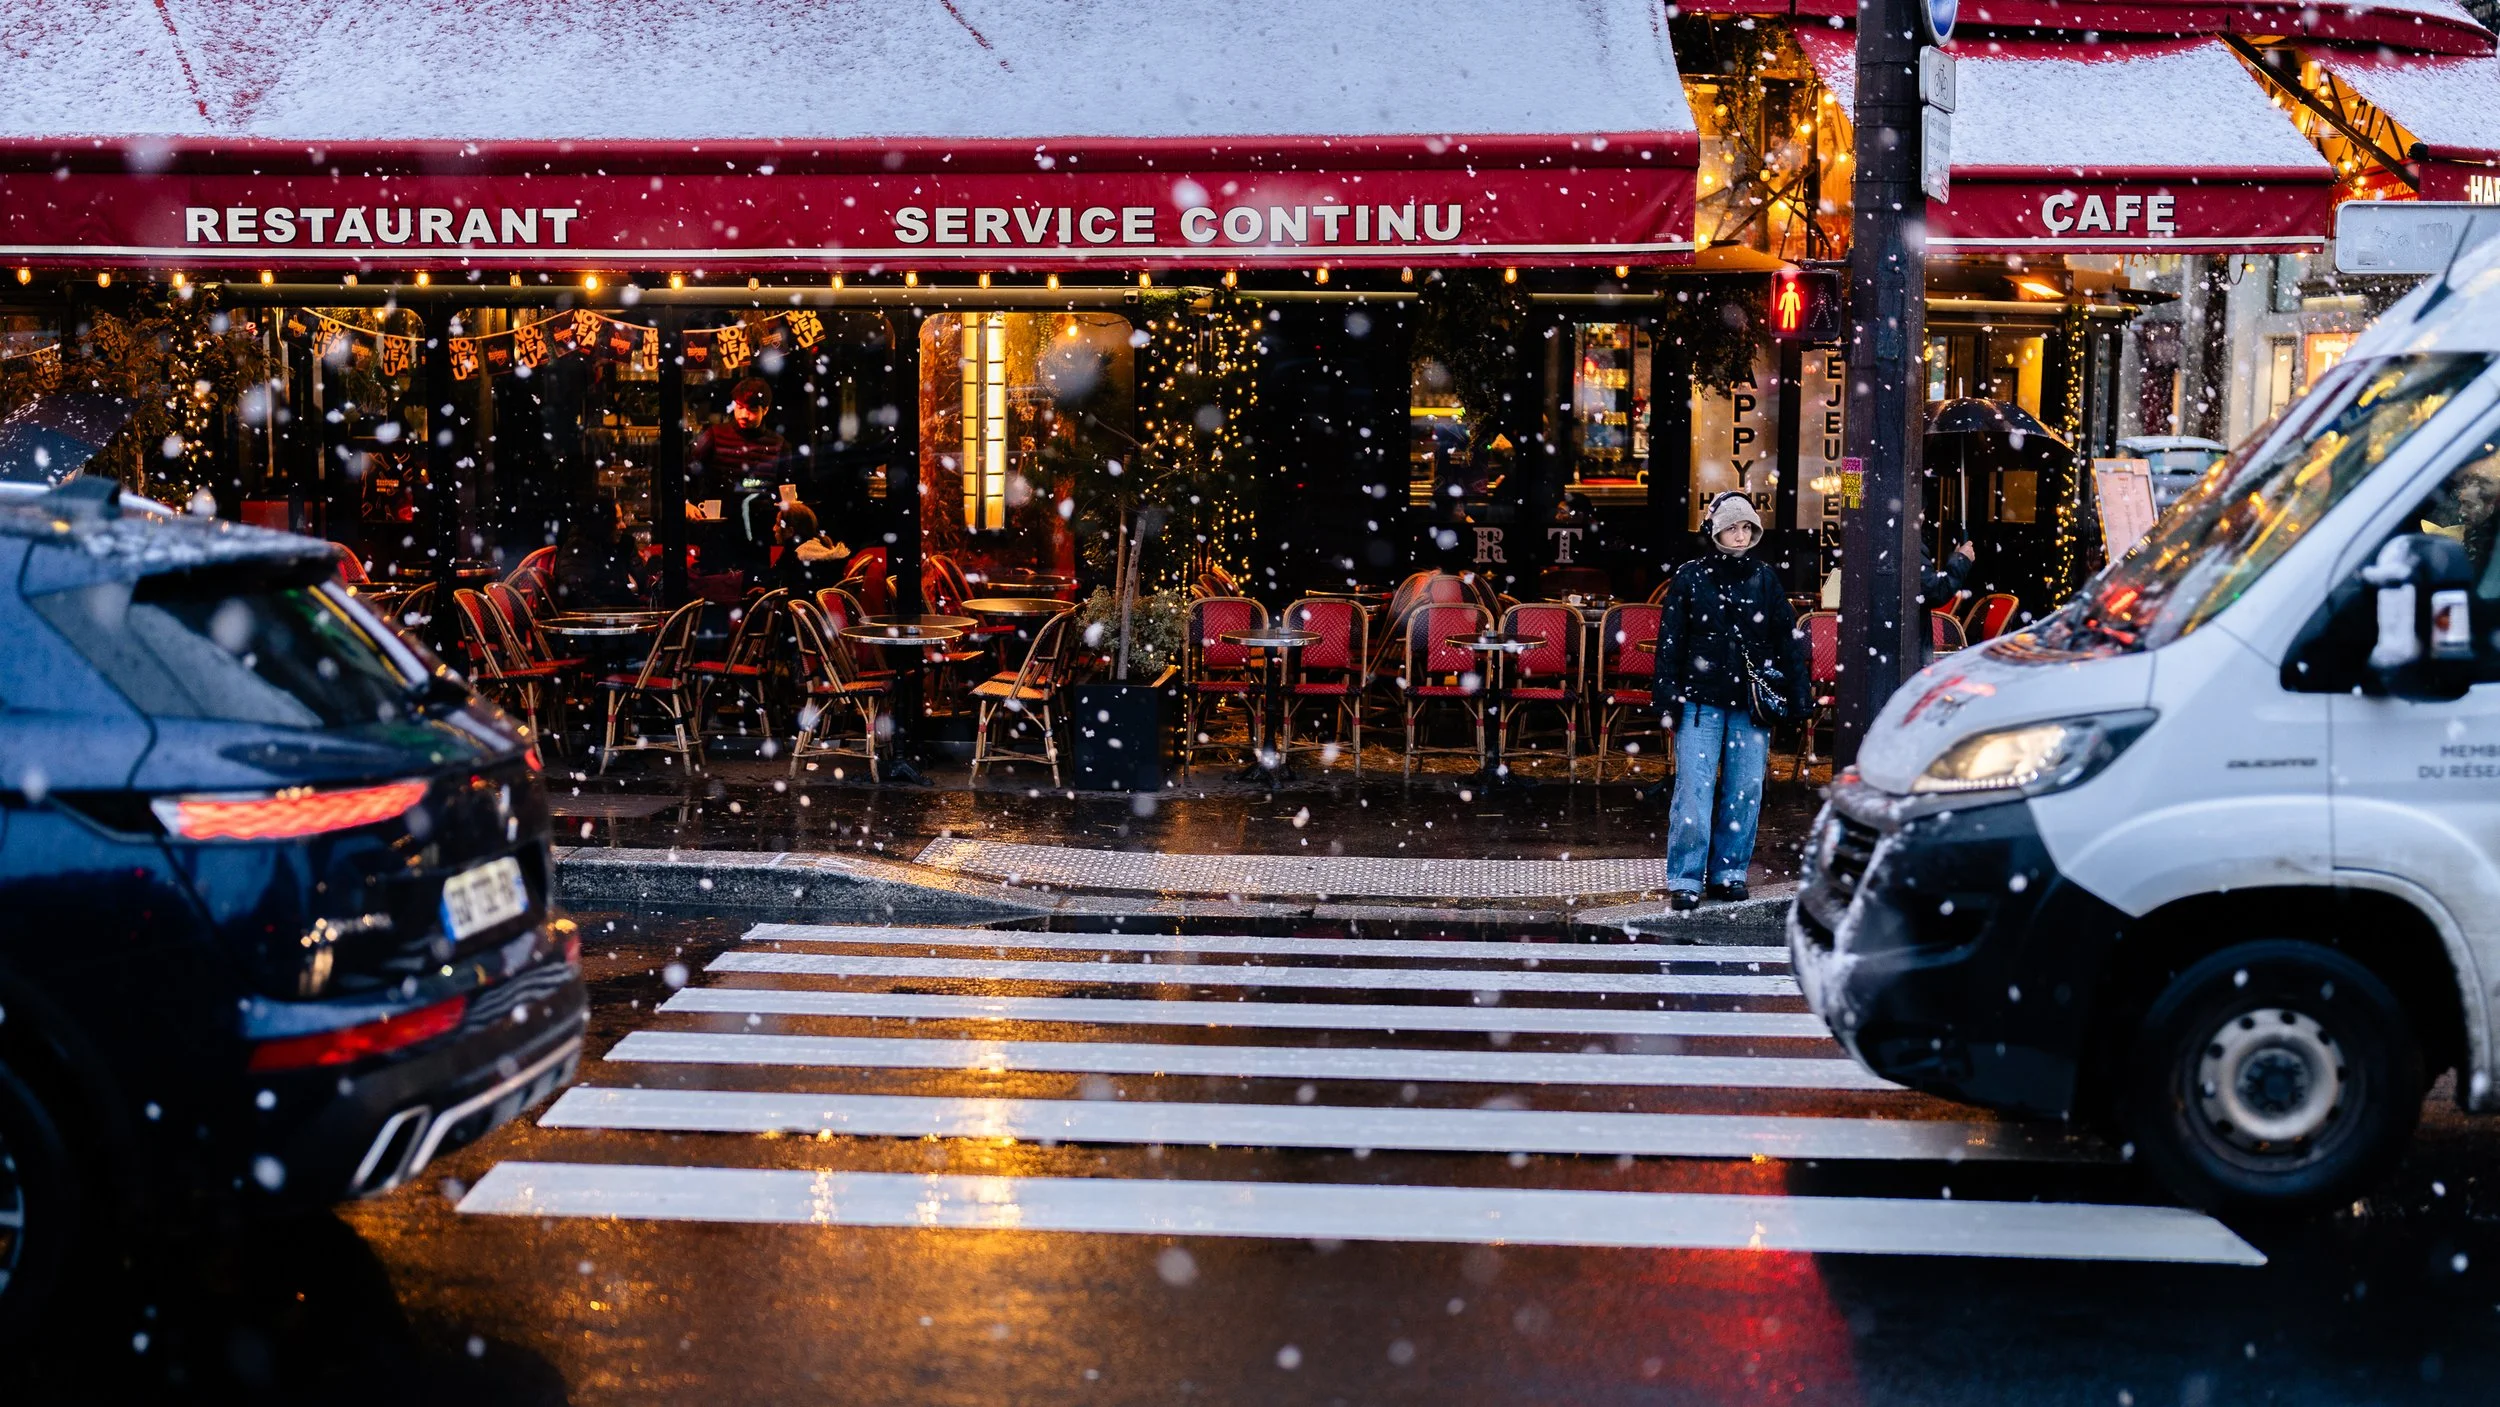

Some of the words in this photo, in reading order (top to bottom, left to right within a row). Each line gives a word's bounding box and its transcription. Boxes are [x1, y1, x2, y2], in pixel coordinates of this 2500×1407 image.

[184, 207, 579, 244] RESTAURANT
[894, 206, 1156, 244] SERVICE
[1180, 204, 1463, 243] CONTINU
[2041, 194, 2176, 231] CAFE
[1730, 361, 1759, 491] APPY
[1698, 492, 1774, 512] HR
